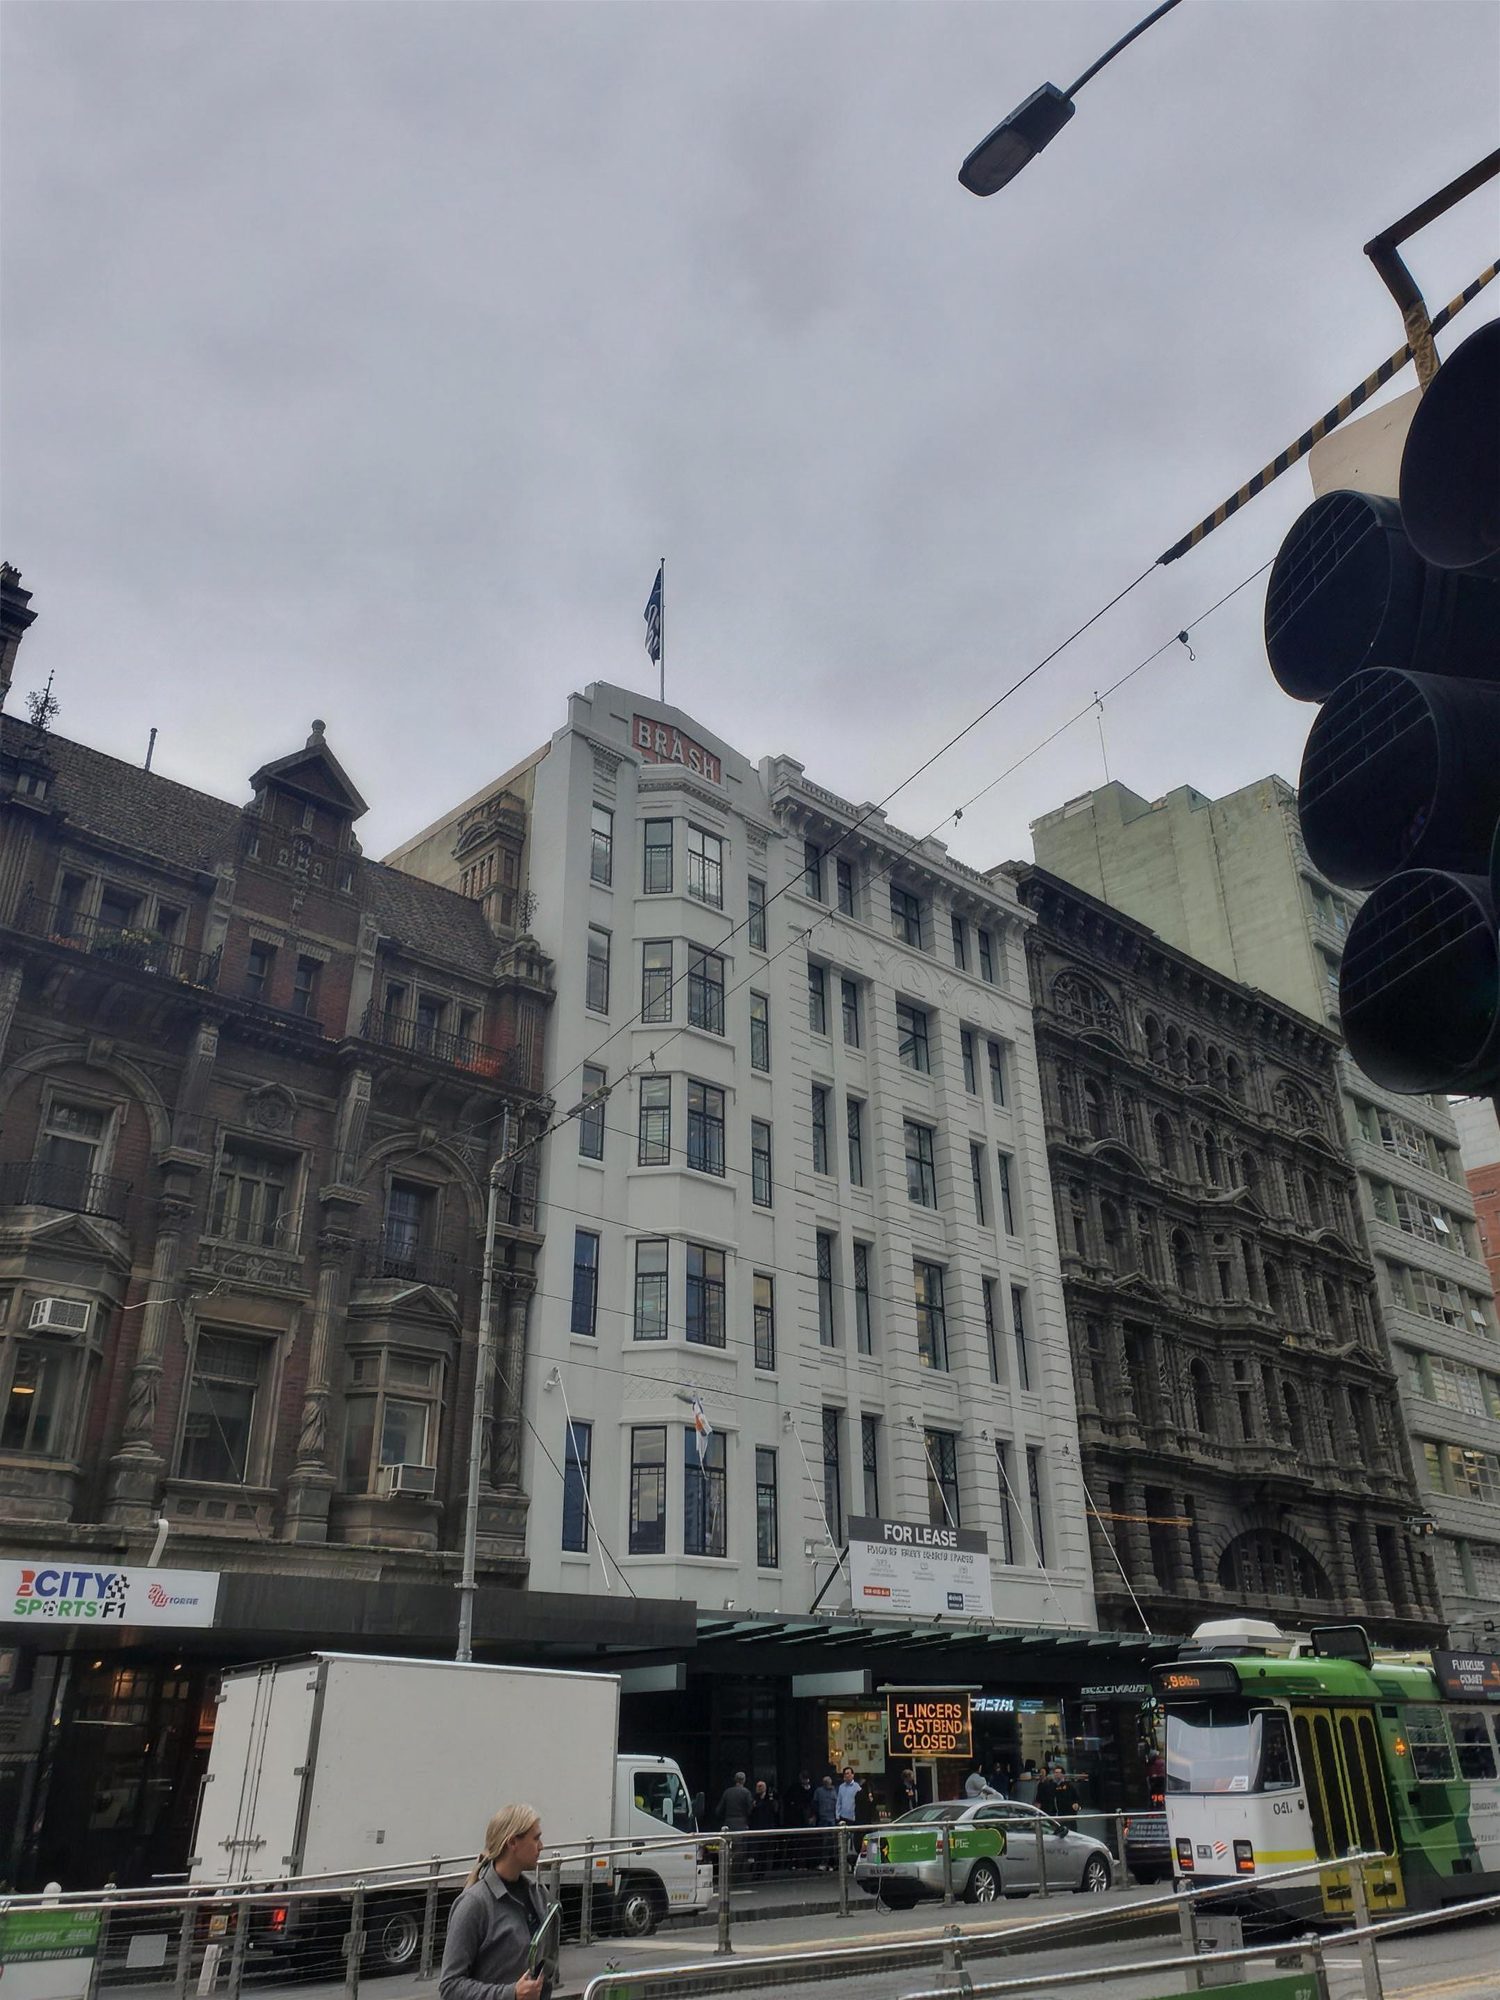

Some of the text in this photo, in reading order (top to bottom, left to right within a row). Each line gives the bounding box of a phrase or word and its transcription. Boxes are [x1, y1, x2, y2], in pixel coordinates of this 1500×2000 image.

[637, 720, 715, 782] BRASH
[884, 1523, 958, 1548] FOR LEASE
[14, 1599, 126, 1619] SPORTS F1
[903, 1734, 957, 1750] CLOSED
